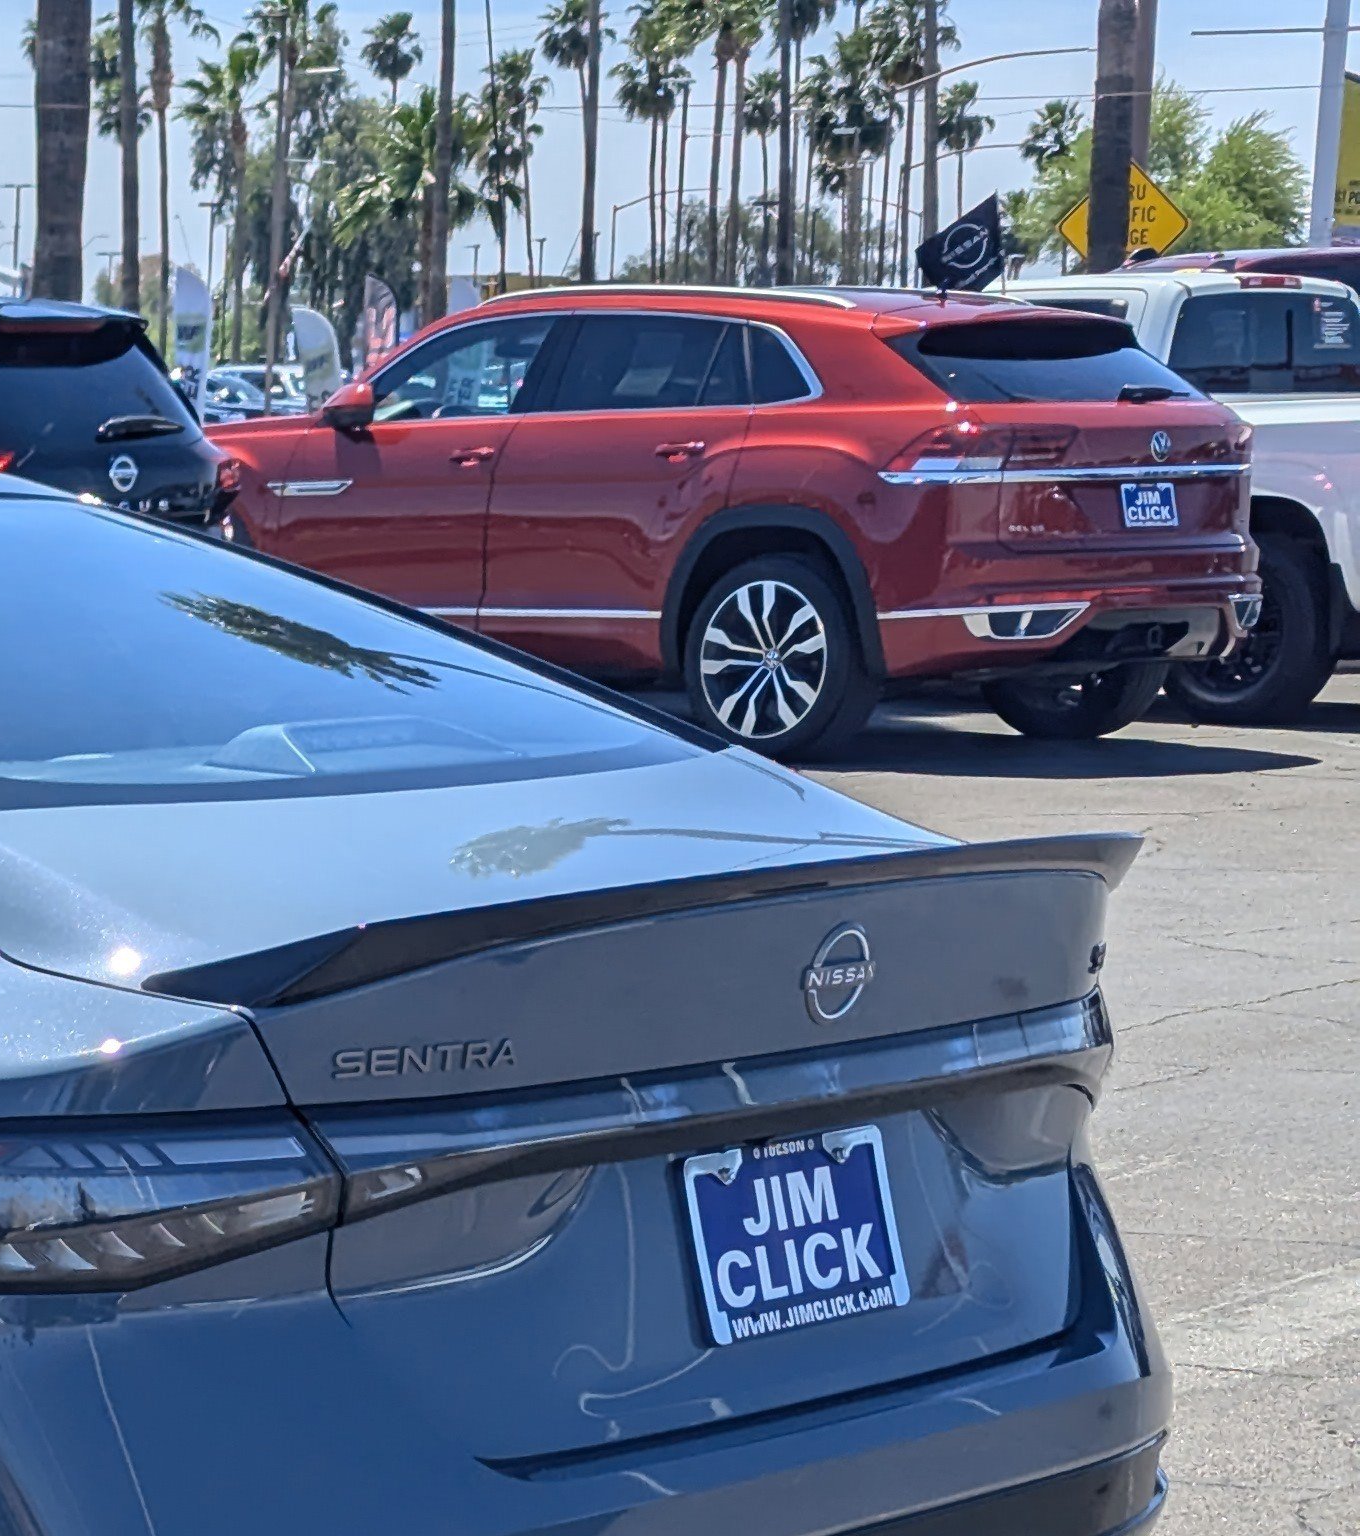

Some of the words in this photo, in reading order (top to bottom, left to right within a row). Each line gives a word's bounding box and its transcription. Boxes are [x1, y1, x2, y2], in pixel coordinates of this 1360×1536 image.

[1127, 505, 1172, 520] CLICK
[1134, 490, 1161, 505] JIM
[807, 964, 875, 988] NISSAN
[331, 1038, 516, 1080] SENTRA
[742, 1165, 840, 1236] JIM
[717, 1222, 883, 1308] CLICK
[732, 1285, 894, 1339] WWW.JIMCLICK.COM
